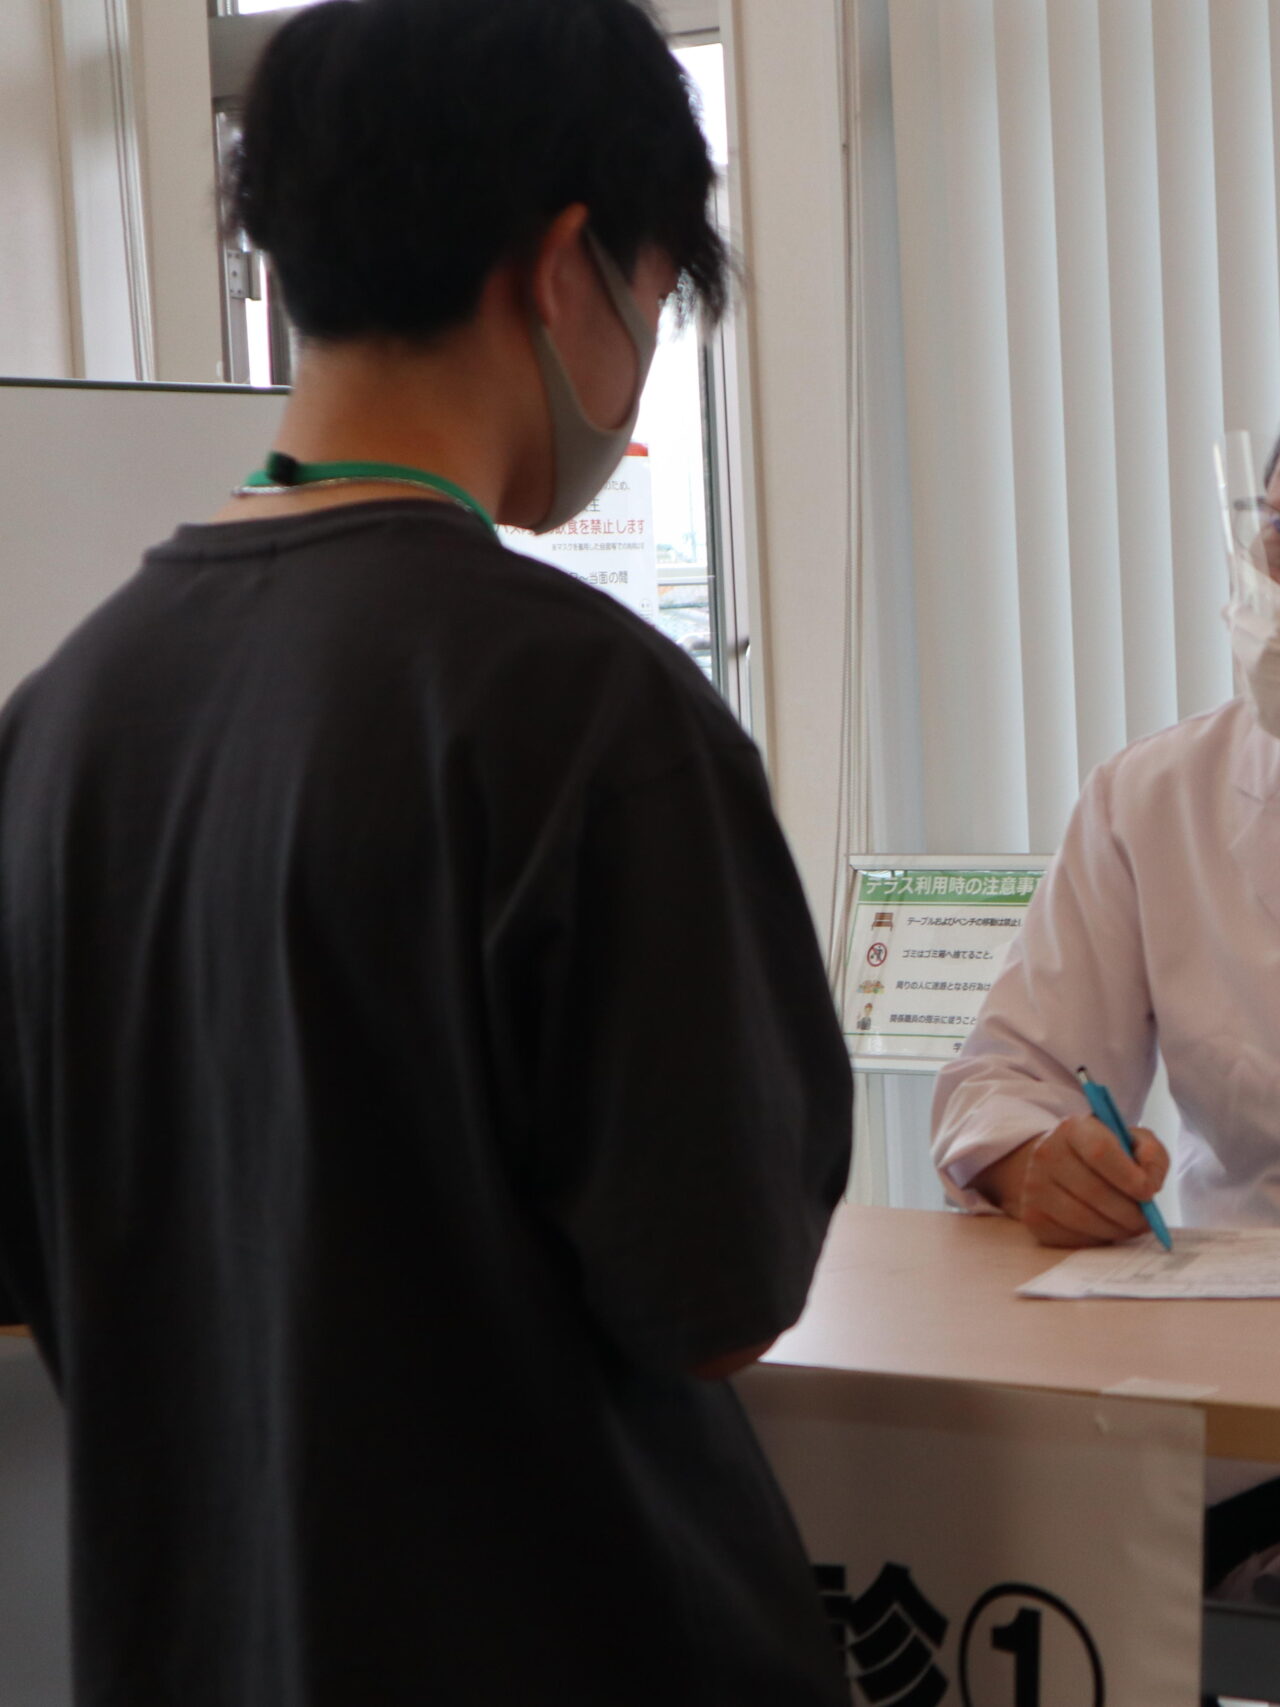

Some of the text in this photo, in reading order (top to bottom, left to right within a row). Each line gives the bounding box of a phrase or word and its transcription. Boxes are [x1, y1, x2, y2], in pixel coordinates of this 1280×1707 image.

[866, 876, 1039, 896] テラス利用時の注意事
